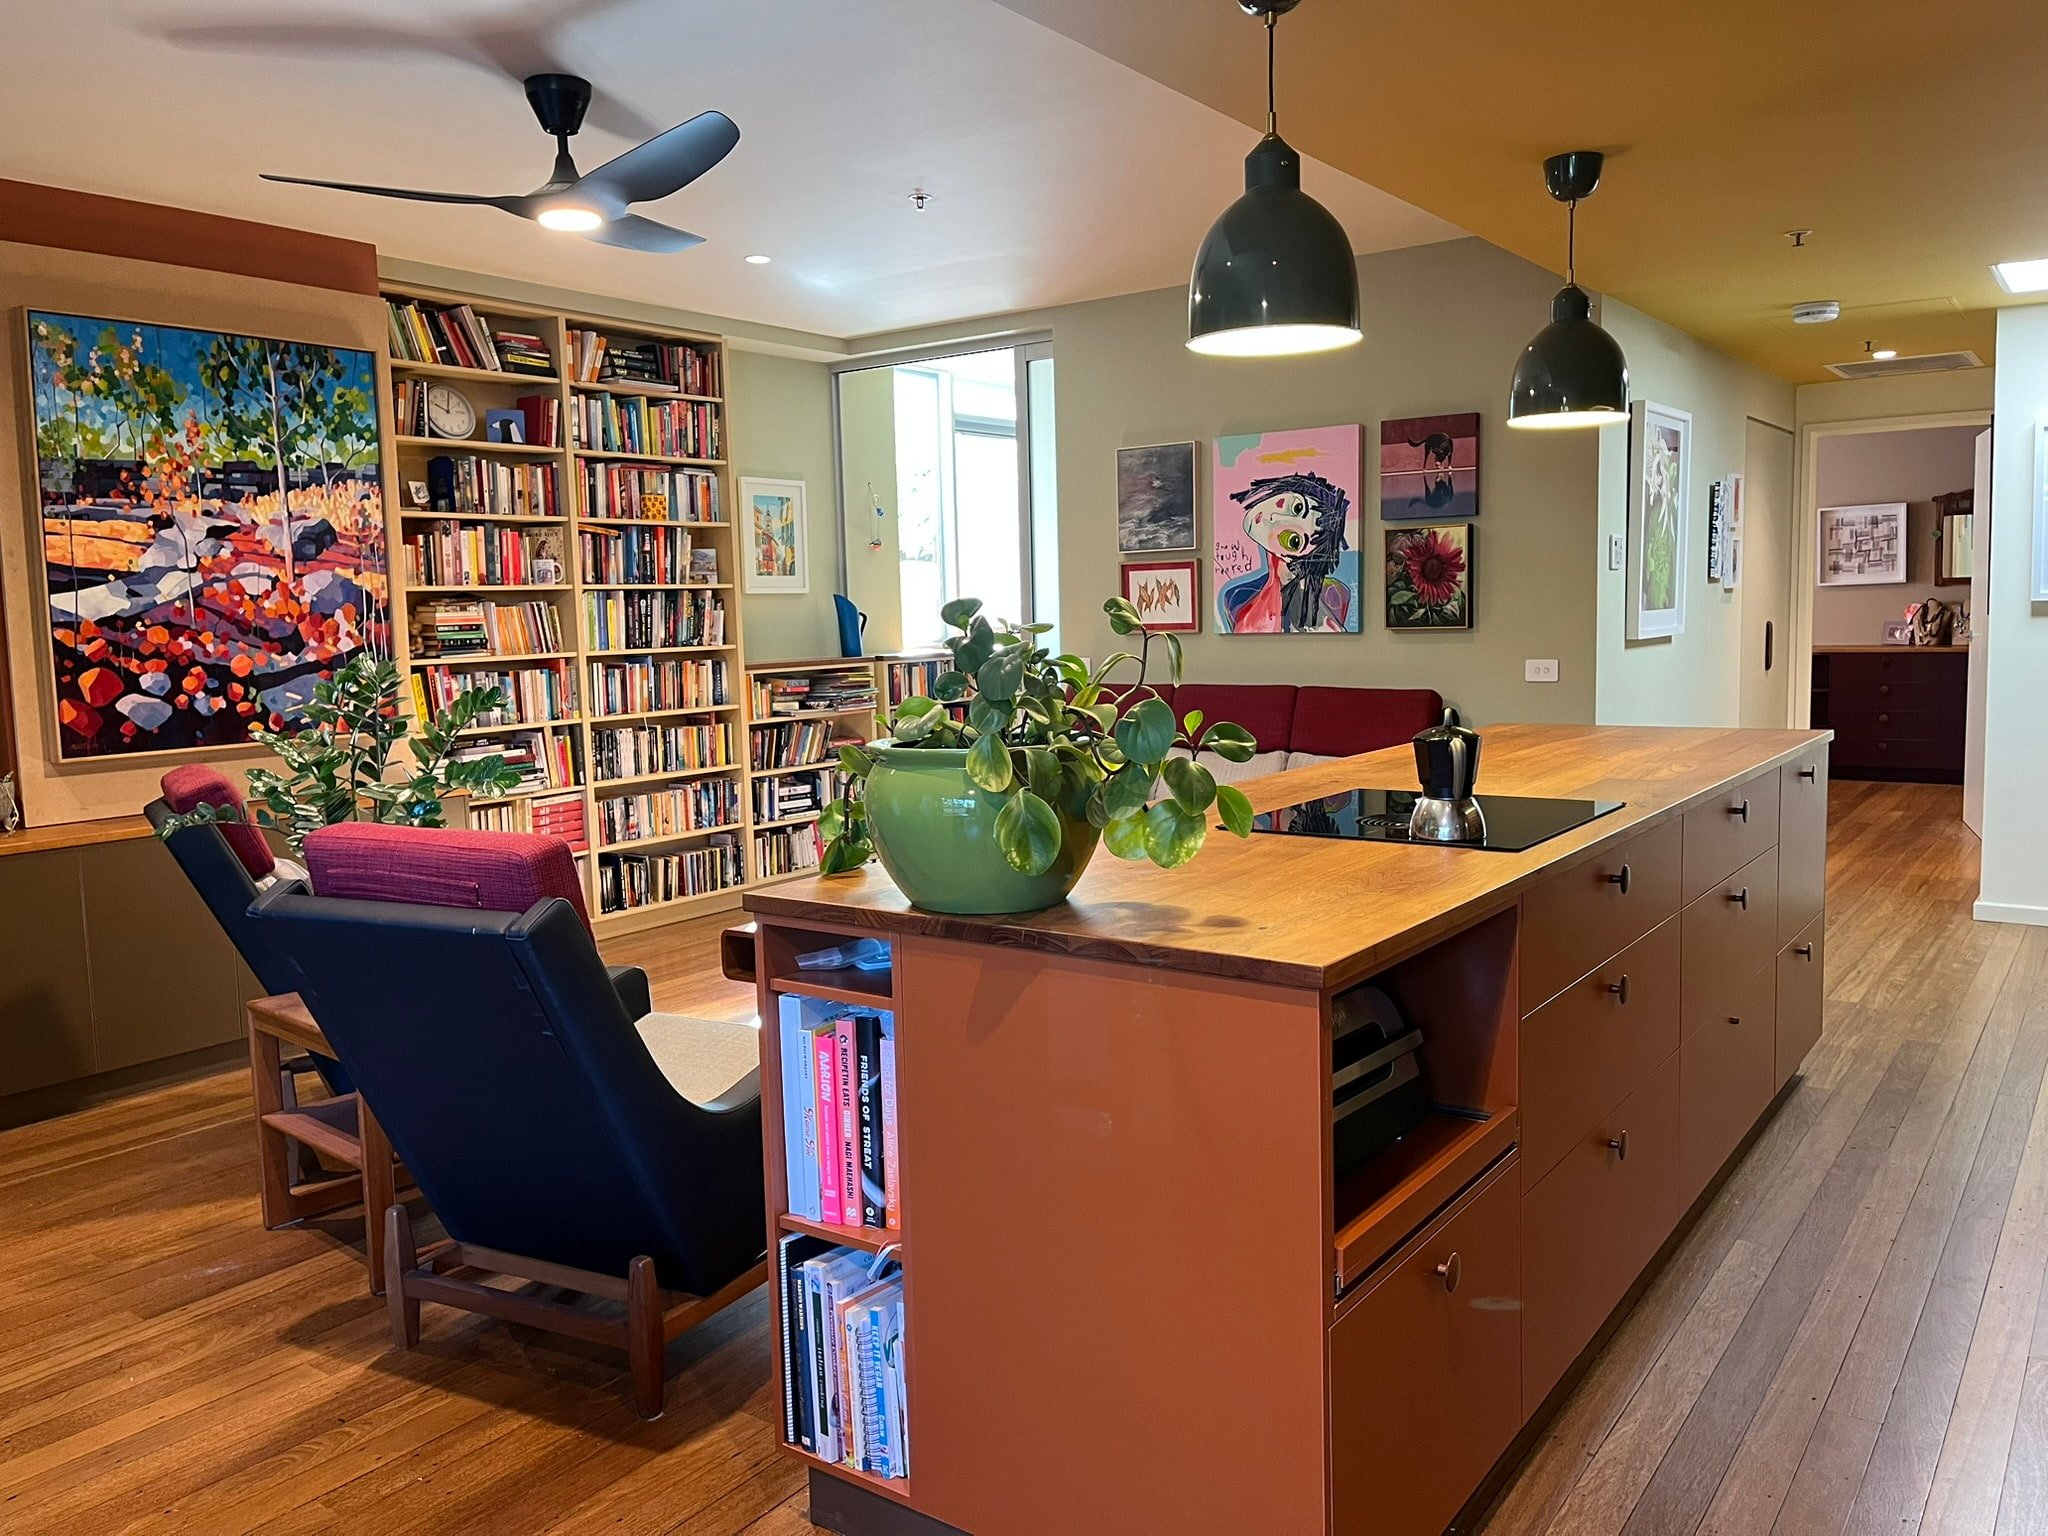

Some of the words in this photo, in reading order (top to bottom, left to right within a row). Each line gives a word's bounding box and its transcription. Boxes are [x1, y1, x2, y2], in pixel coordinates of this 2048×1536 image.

[819, 1051, 832, 1102] MARION
[840, 1048, 849, 1086] RECIPETIN
[883, 1049, 892, 1078] Salad
[860, 1055, 869, 1103] FRIENDS
[884, 1080, 893, 1096] for
[842, 1088, 850, 1106] EATS
[862, 1105, 870, 1120] OF
[884, 1099, 895, 1125] Days
[844, 1141, 852, 1159] NAGI
[863, 1127, 872, 1169] STREAT
[886, 1131, 896, 1157] Alice
[846, 1161, 854, 1199] MAEHASHI
[886, 1161, 897, 1211] Zaslavsky
[872, 1325, 881, 1348] KEEP
[873, 1350, 881, 1360] IT
[874, 1362, 883, 1388] VEGAN
